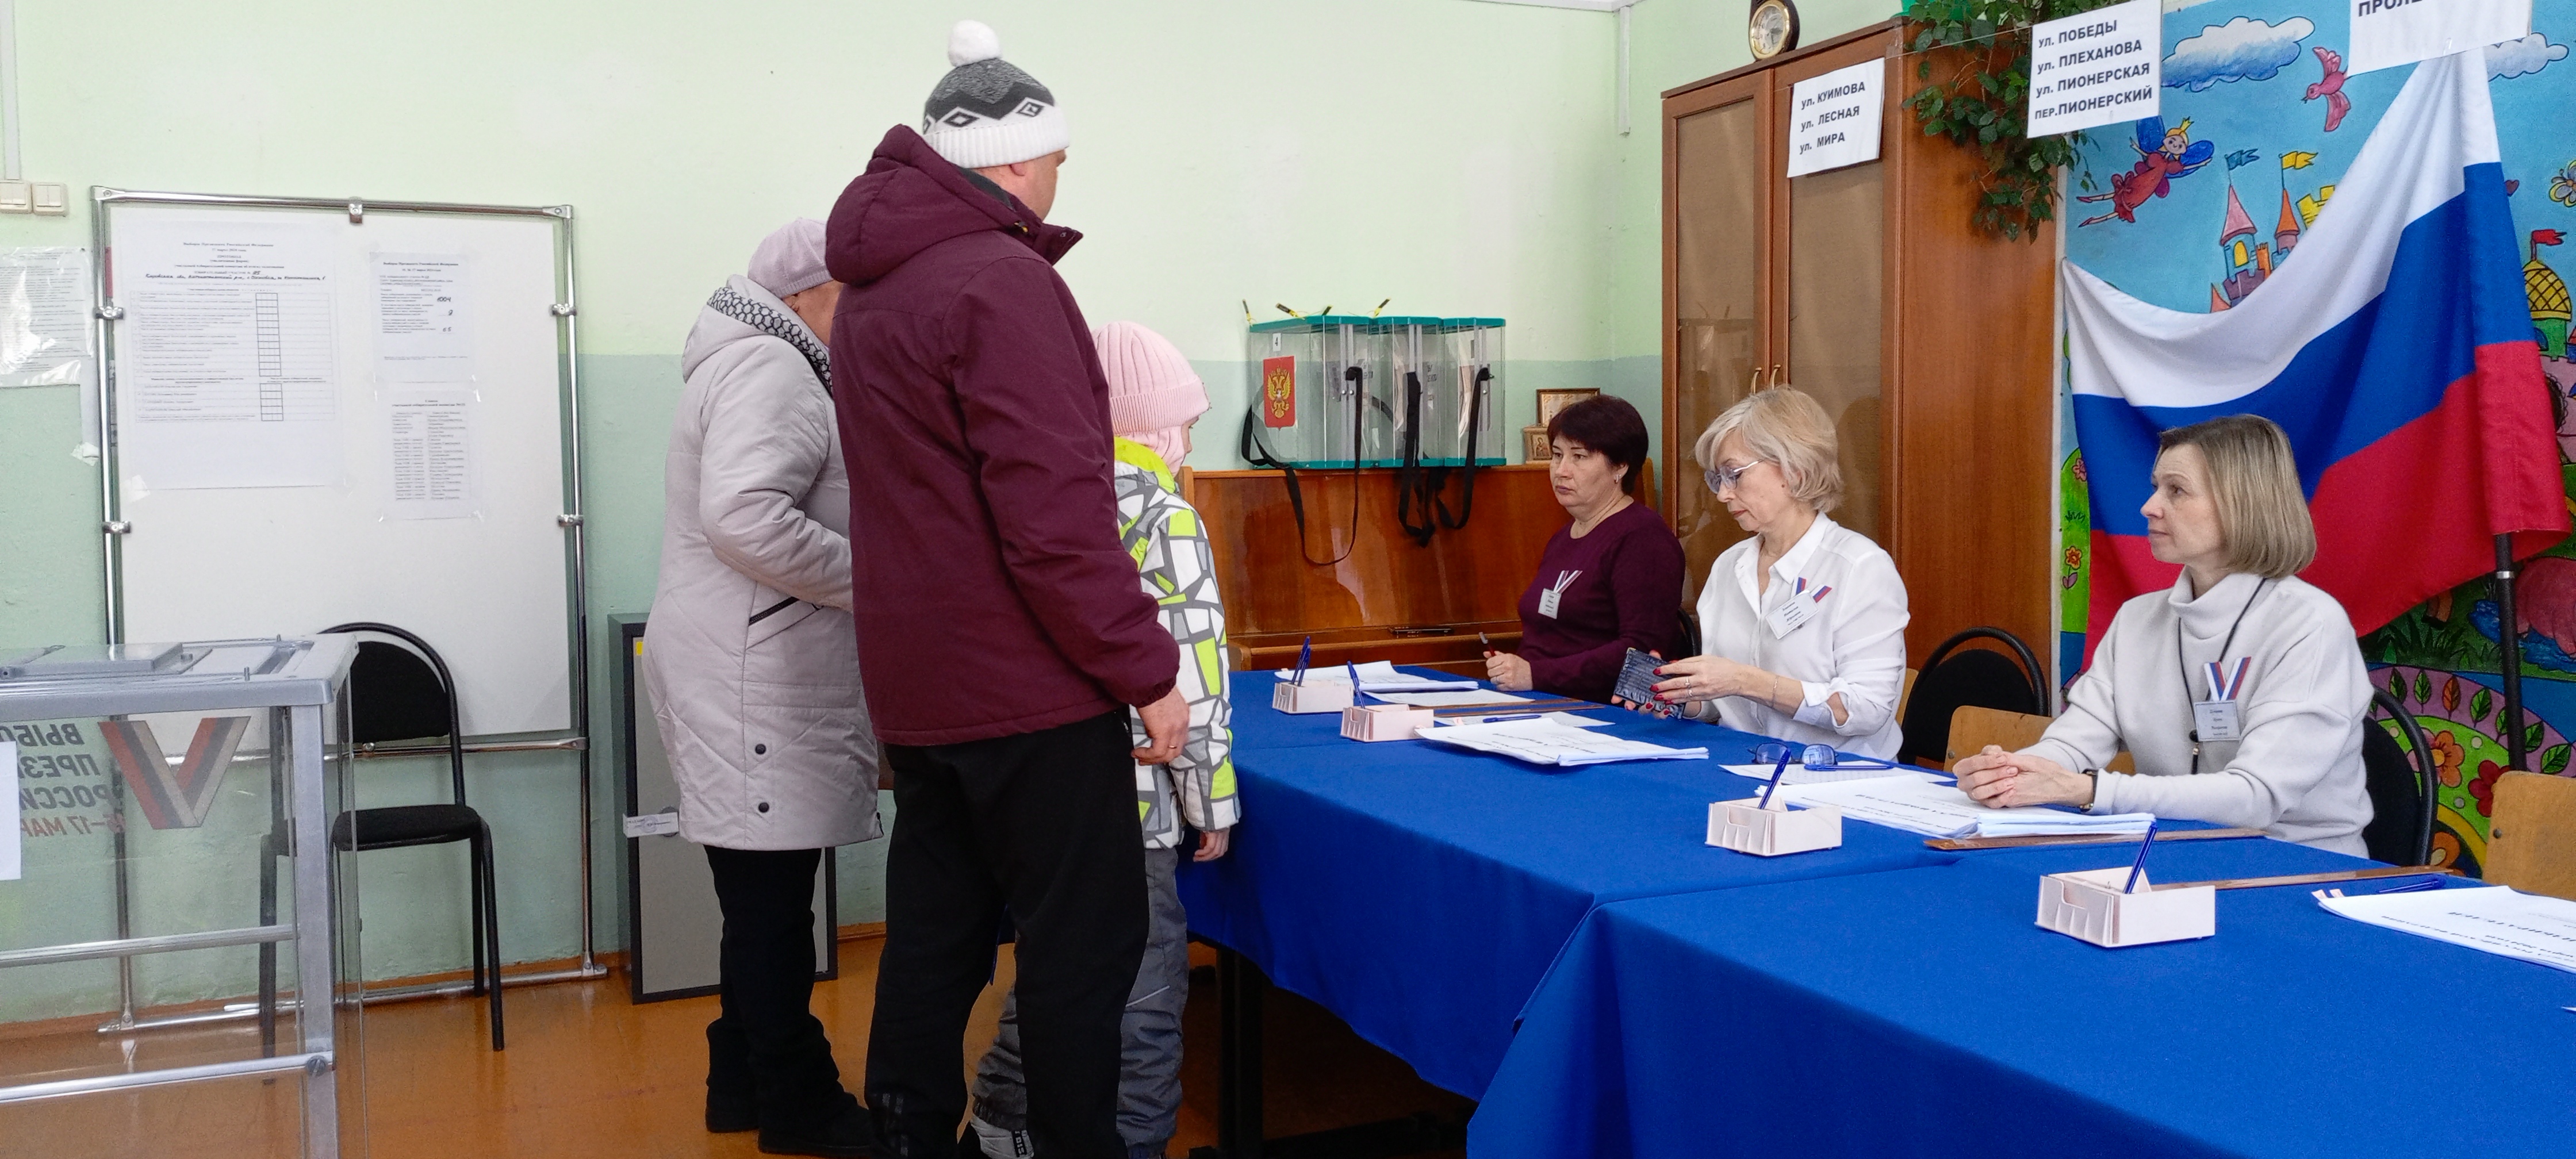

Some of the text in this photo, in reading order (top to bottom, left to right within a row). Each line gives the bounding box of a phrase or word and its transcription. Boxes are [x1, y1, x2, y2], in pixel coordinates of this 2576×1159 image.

[2358, 0, 2422, 17] ПРО
[2058, 20, 2117, 43] ПОБЕДЫ
[2037, 40, 2142, 75] ул. ПЛЕХАНОВА
[2036, 63, 2150, 98] ул. ПИОНЕРСКАЯ
[1801, 82, 1865, 110] ул. КУИМОВА
[1800, 106, 1860, 133] ул. ЛЕСНАЯ
[1799, 132, 1845, 155] ул. МИРА
[1274, 336, 1279, 347] 4
